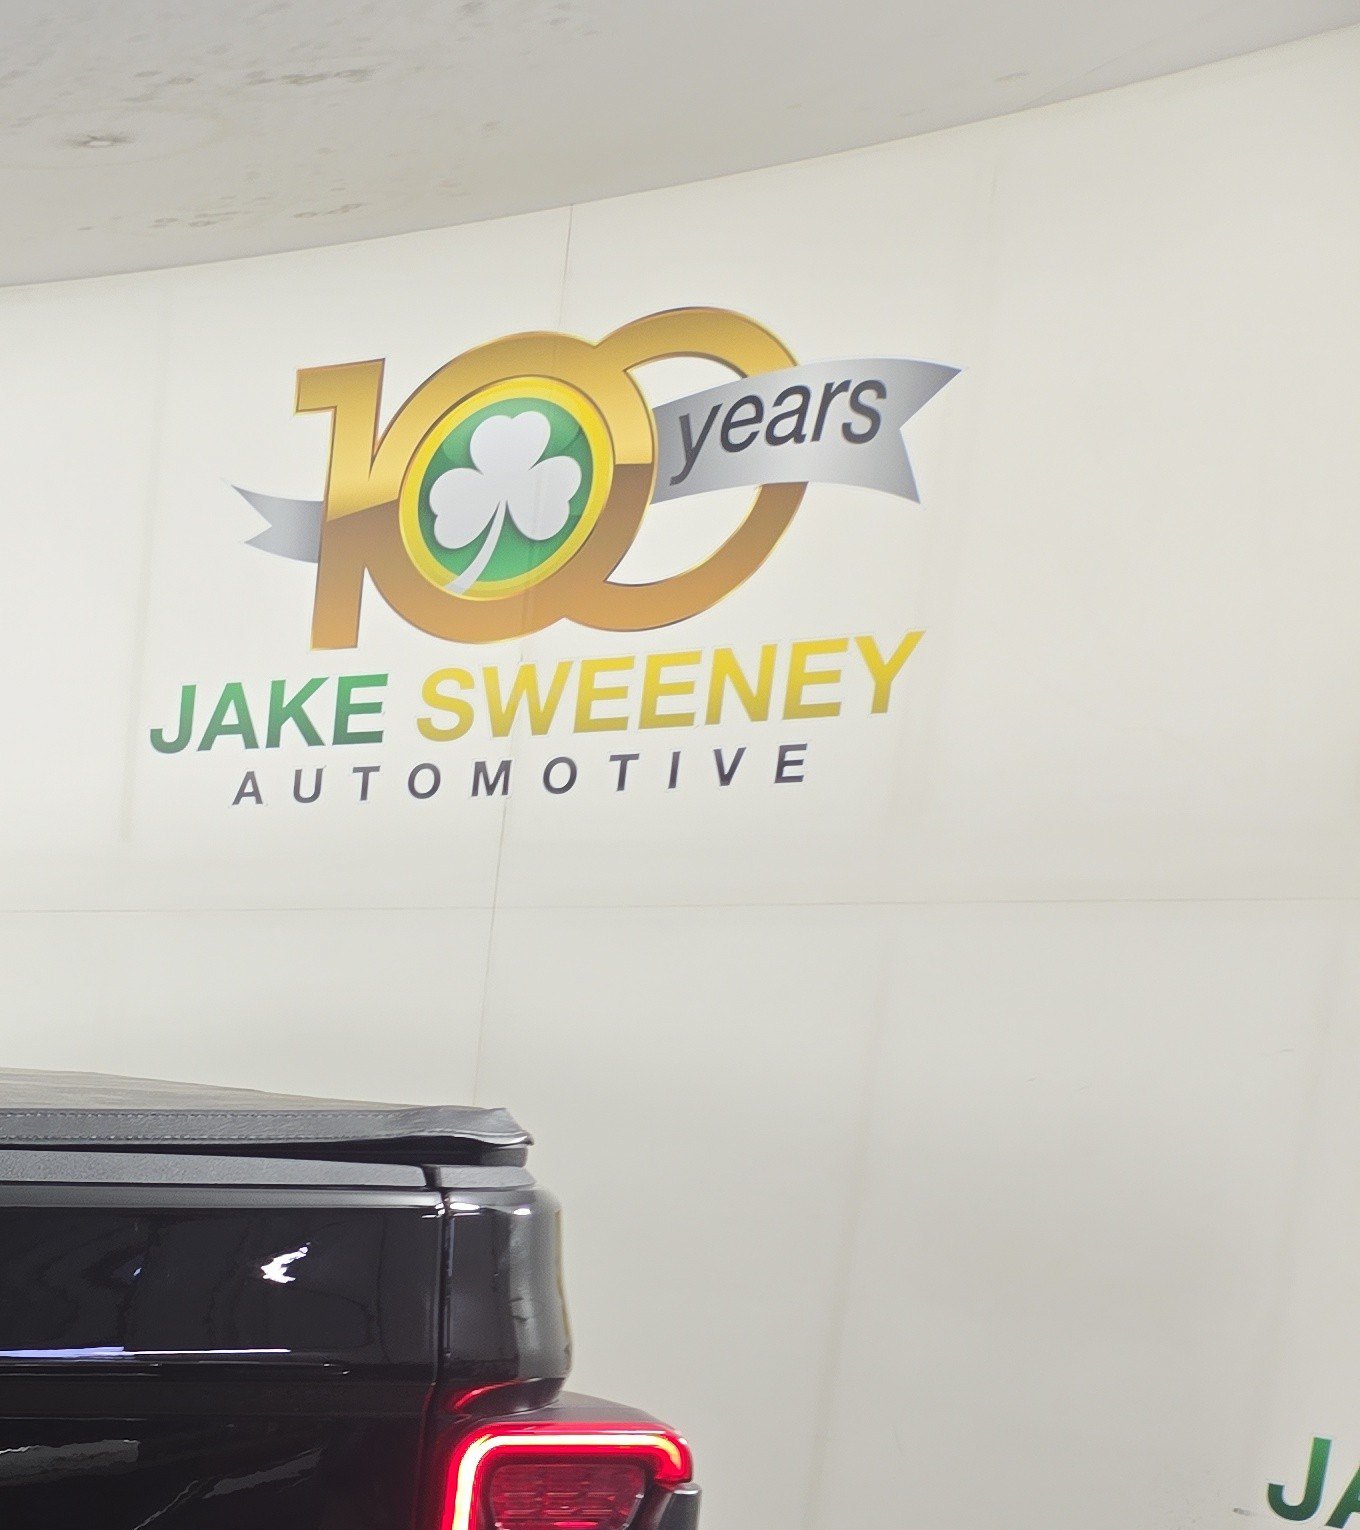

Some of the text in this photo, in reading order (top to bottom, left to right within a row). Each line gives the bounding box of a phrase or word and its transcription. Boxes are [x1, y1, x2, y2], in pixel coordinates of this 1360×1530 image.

[670, 378, 887, 485] years
[149, 630, 926, 753] JAKE SWEENEY
[232, 743, 808, 805] AUTOMOTIVE
